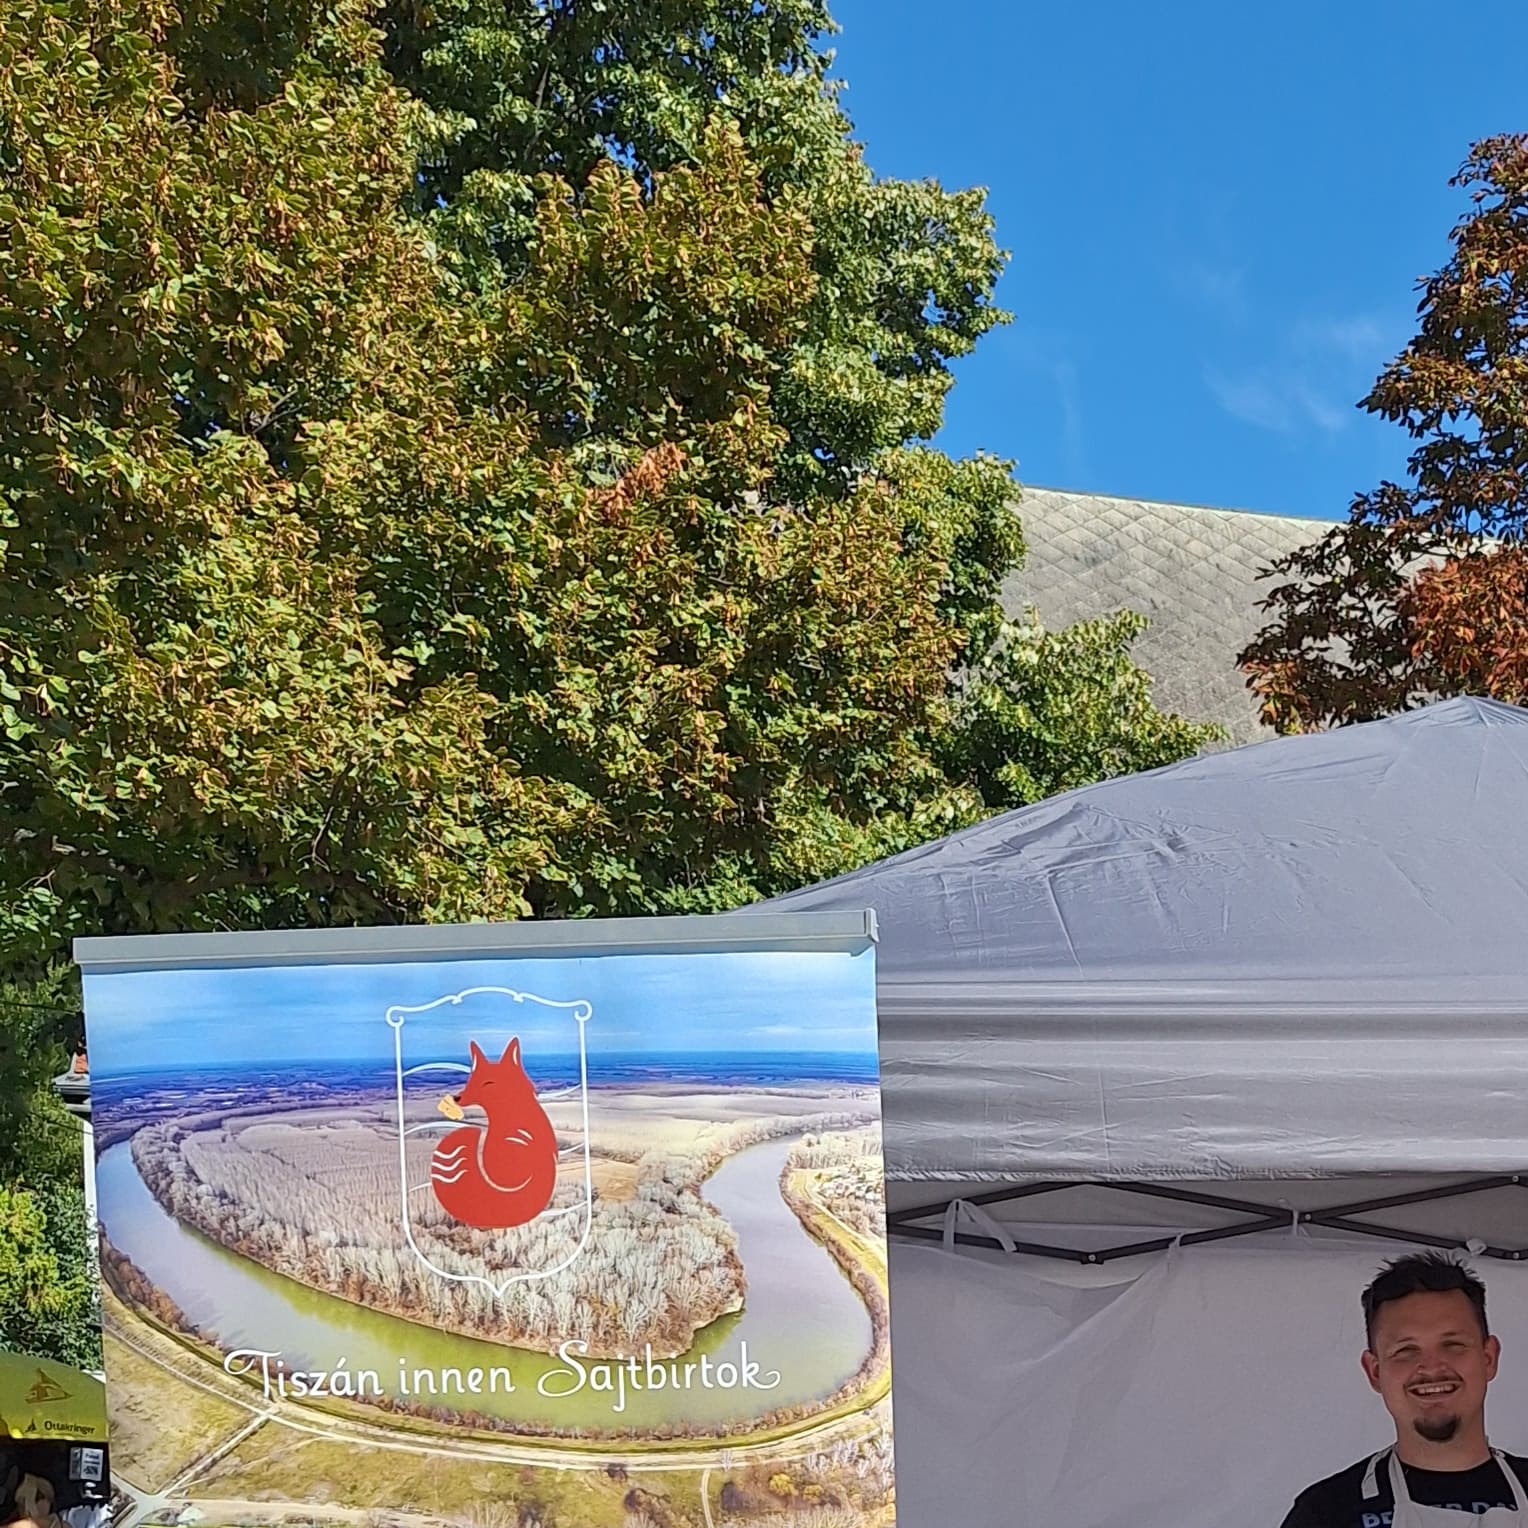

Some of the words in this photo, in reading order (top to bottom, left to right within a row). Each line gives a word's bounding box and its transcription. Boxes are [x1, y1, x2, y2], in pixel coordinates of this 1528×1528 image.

[223, 1349, 385, 1401] Tiszán
[399, 1357, 515, 1395] innen
[537, 1340, 782, 1411] Sajtbirtok
[45, 1421, 96, 1434] Ottakringer
